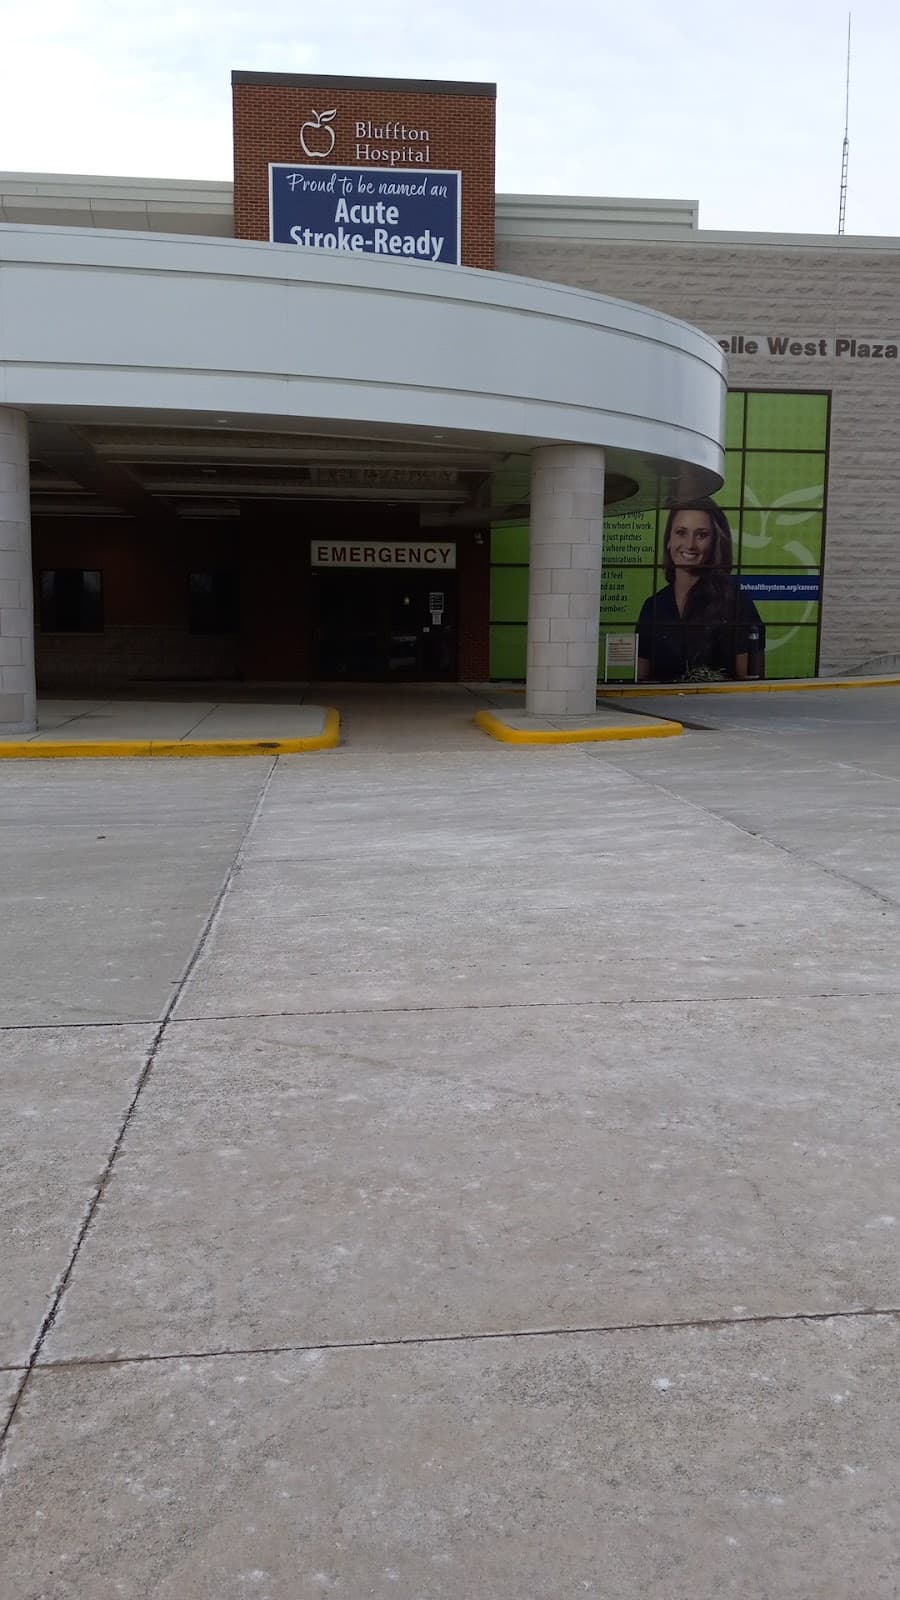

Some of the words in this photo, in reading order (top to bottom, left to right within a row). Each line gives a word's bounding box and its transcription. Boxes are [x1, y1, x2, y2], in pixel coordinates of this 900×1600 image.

[355, 121, 430, 141] Bluffton
[355, 143, 430, 165] Hospital
[286, 173, 337, 194] Proud
[337, 177, 353, 196] to
[357, 175, 375, 194] be
[378, 177, 428, 197] named
[430, 185, 448, 198] an
[334, 197, 400, 225] Acute
[289, 225, 444, 262] Stroke-Ready
[767, 337, 827, 356] West
[835, 339, 898, 359] Plaza
[318, 546, 451, 564] EMERGENCY
